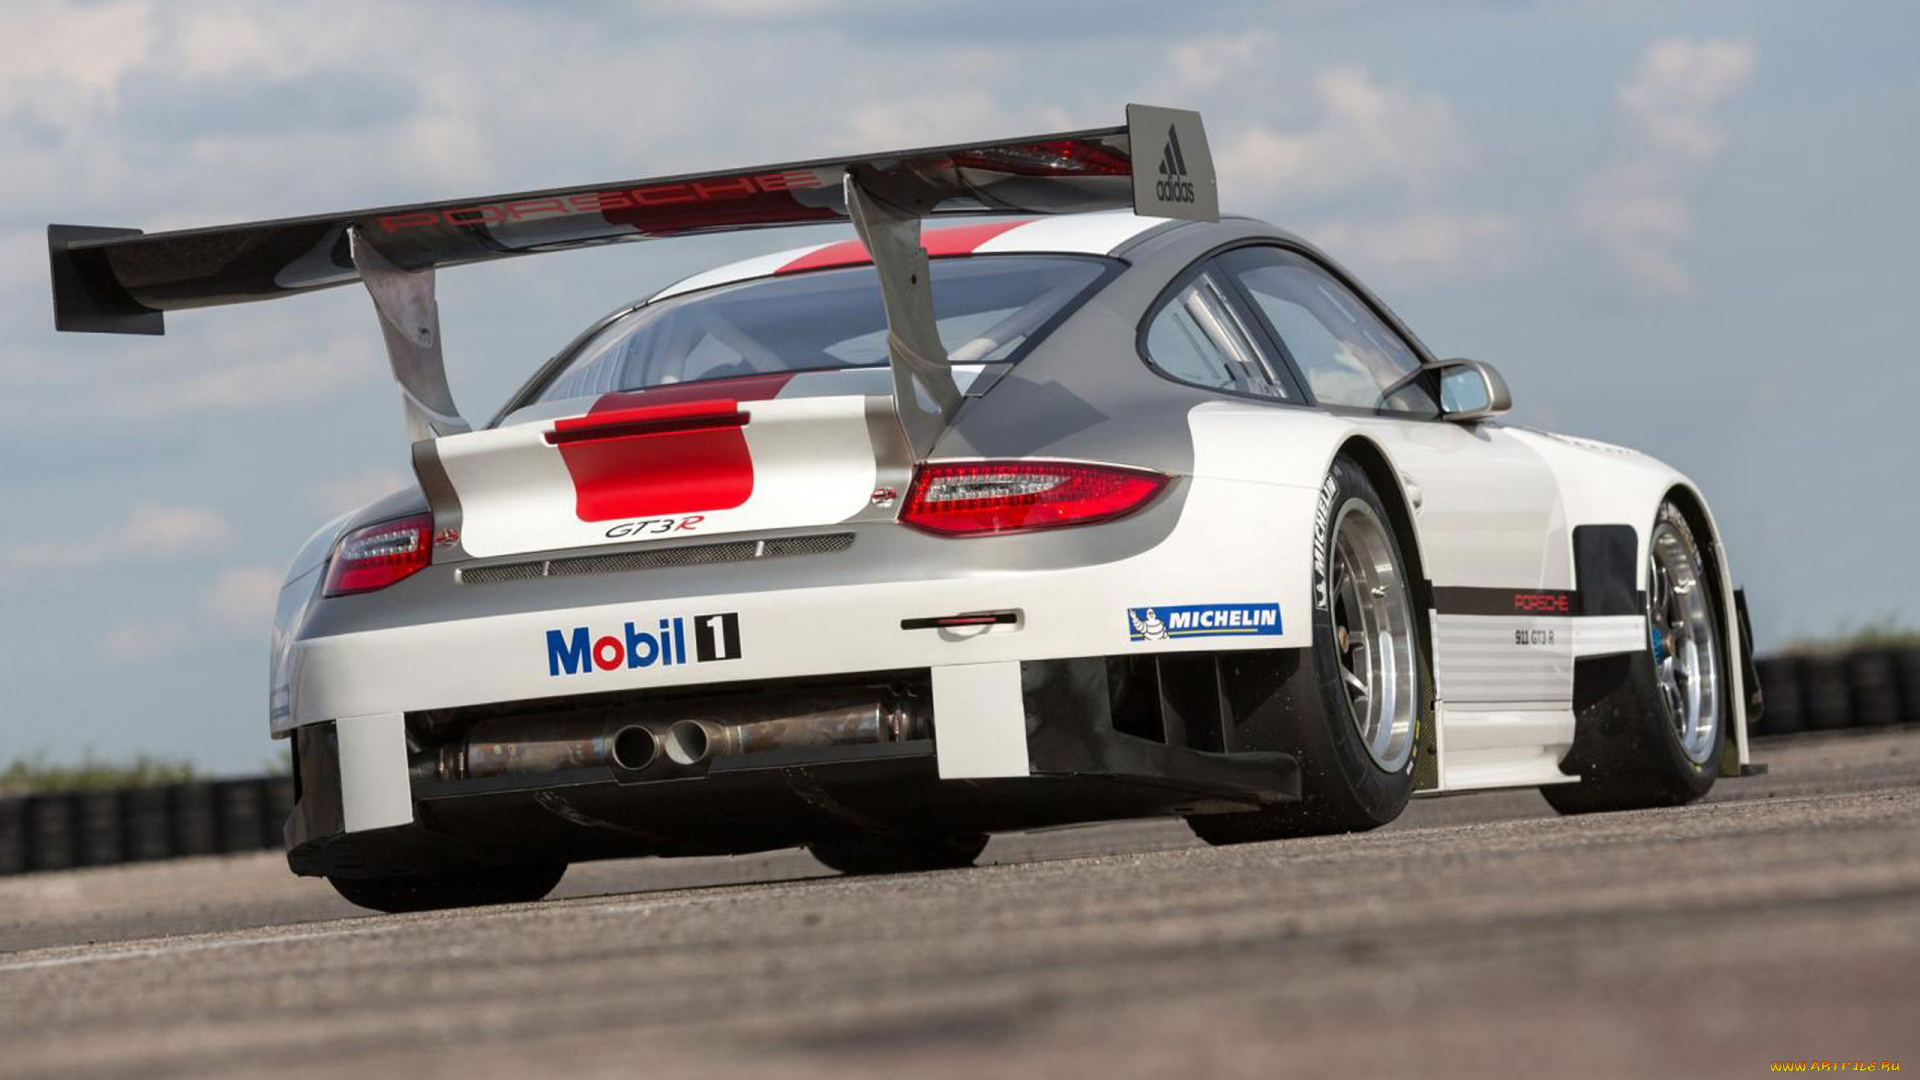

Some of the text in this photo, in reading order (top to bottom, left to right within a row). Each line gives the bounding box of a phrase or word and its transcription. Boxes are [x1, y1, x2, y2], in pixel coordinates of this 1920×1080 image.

[378, 170, 822, 233] PORSCHE
[1156, 174, 1195, 203] adidas
[1314, 476, 1337, 576] MICHELIN
[1514, 594, 1568, 610] PORSCHE
[1169, 609, 1277, 629] MICHELIN
[546, 617, 686, 676] Mobil
[1515, 630, 1529, 645] 911
